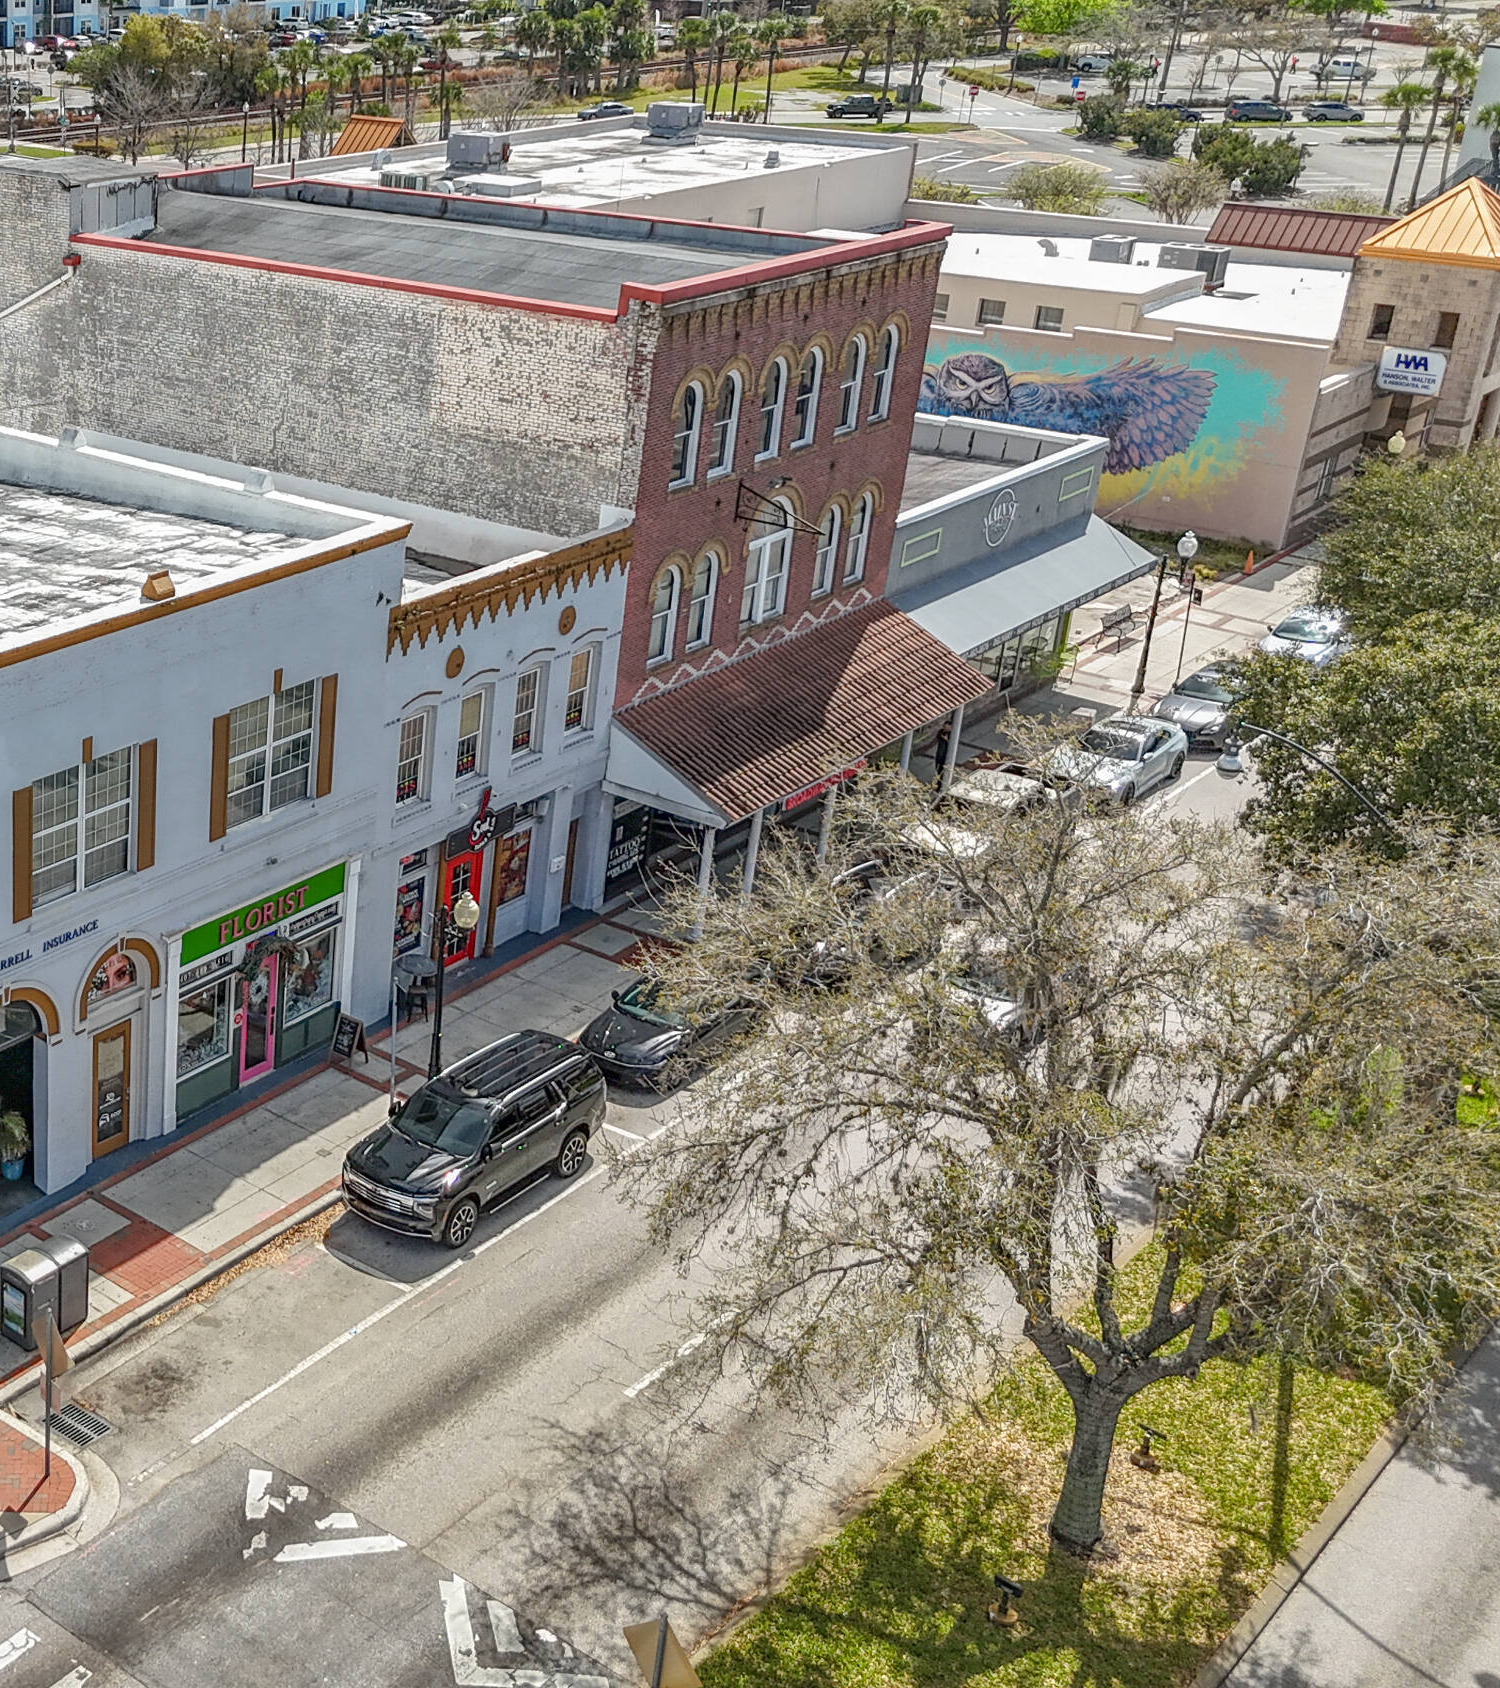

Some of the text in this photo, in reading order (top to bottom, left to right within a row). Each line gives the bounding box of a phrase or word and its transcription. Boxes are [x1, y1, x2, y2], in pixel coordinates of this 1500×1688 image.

[1395, 353, 1428, 371] HWA
[1411, 376, 1437, 385] WALTER
[609, 835, 641, 860] TATTOO
[219, 885, 309, 945] FLORIST
[42, 919, 99, 953] INSURANCE
